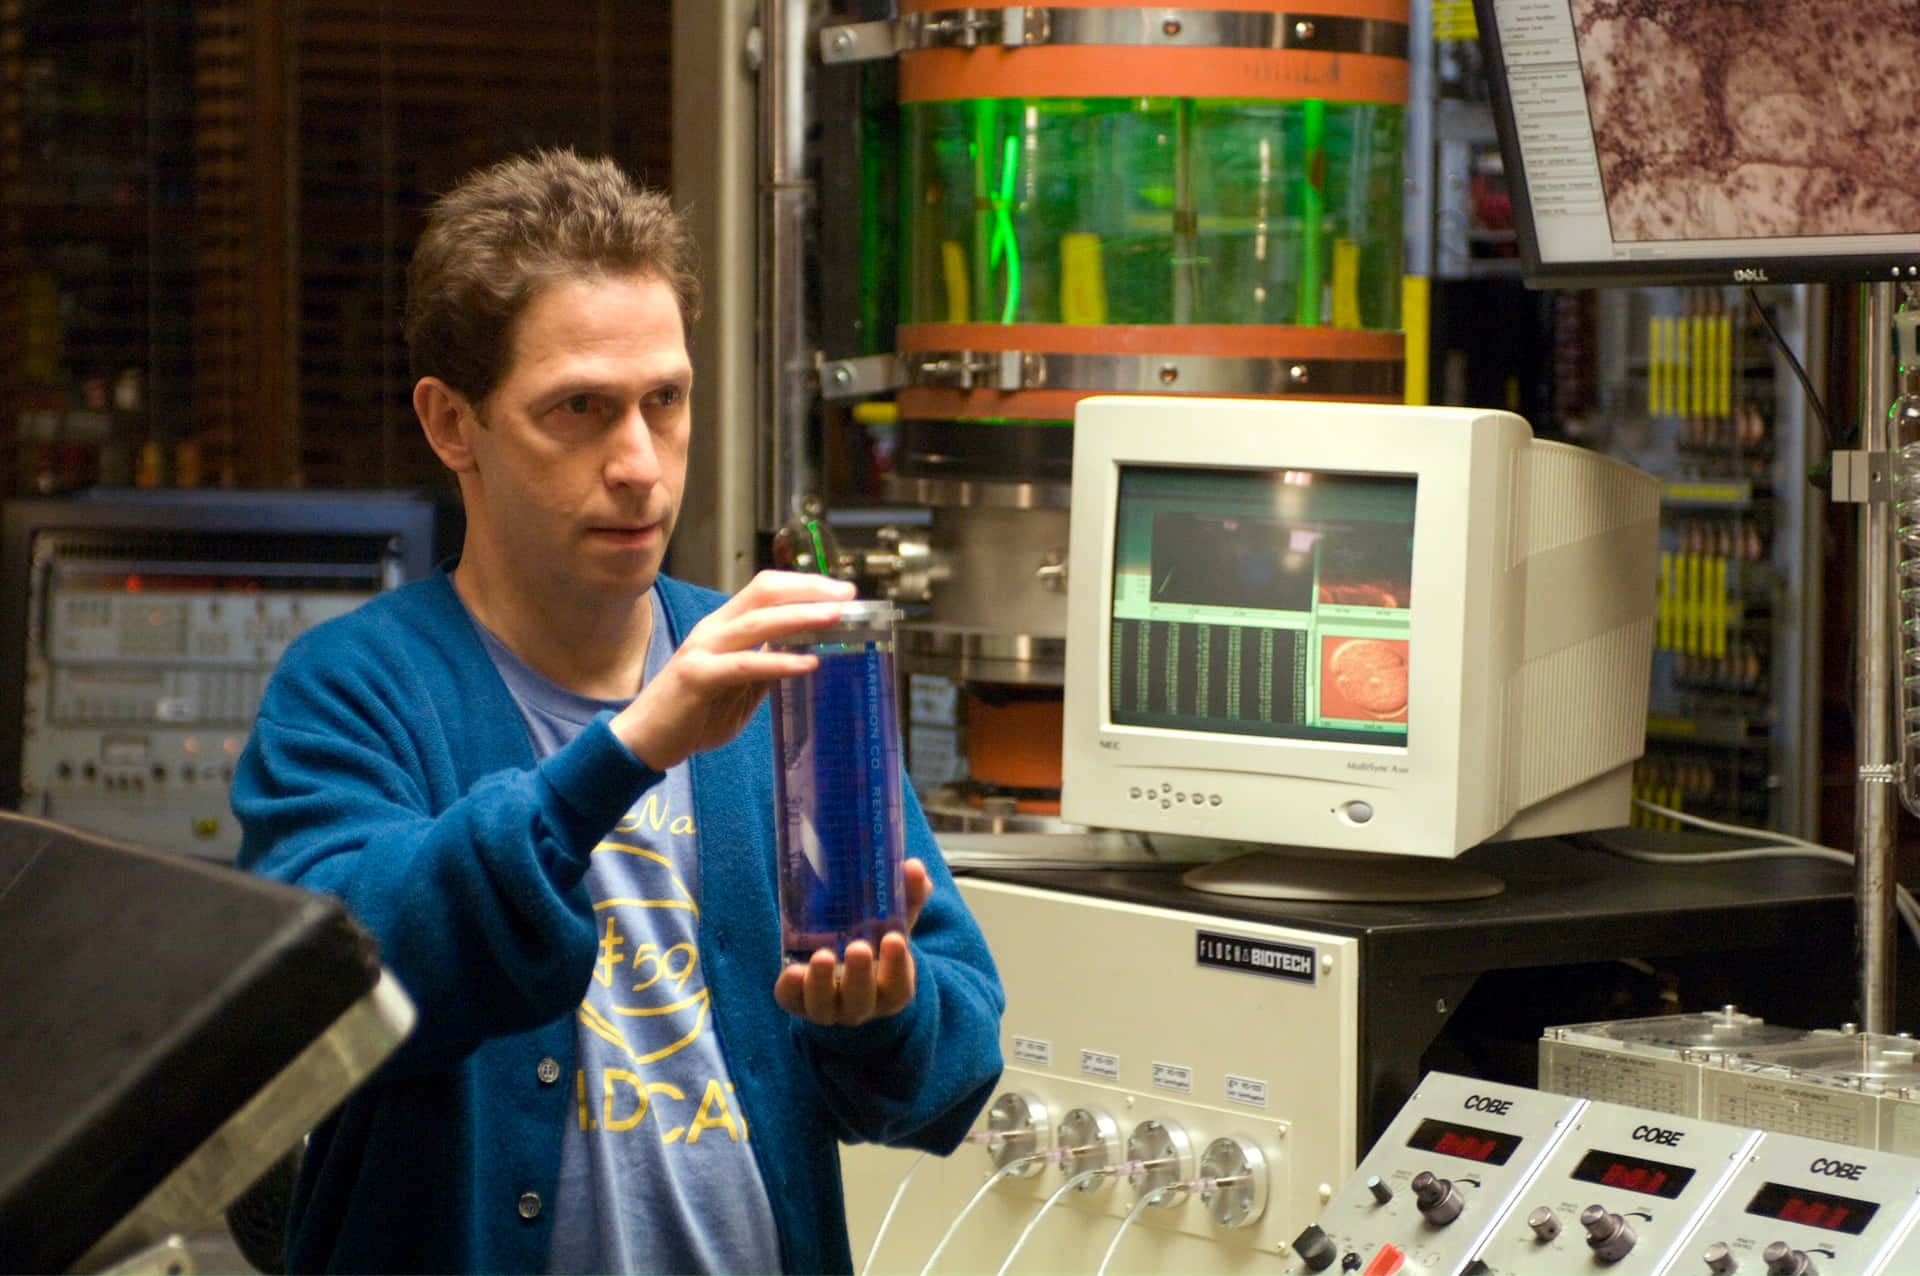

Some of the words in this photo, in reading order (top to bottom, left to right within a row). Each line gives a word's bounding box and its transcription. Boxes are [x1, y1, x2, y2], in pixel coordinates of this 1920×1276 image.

[1734, 268, 1768, 281] DELL
[867, 649, 879, 739] HARRISON
[874, 845, 887, 914] NEVADA
[1251, 947, 1312, 974] BIOTECH
[1463, 1094, 1514, 1117] COBE
[1631, 1124, 1684, 1147] COBE
[1809, 1157, 1867, 1181] COBE
